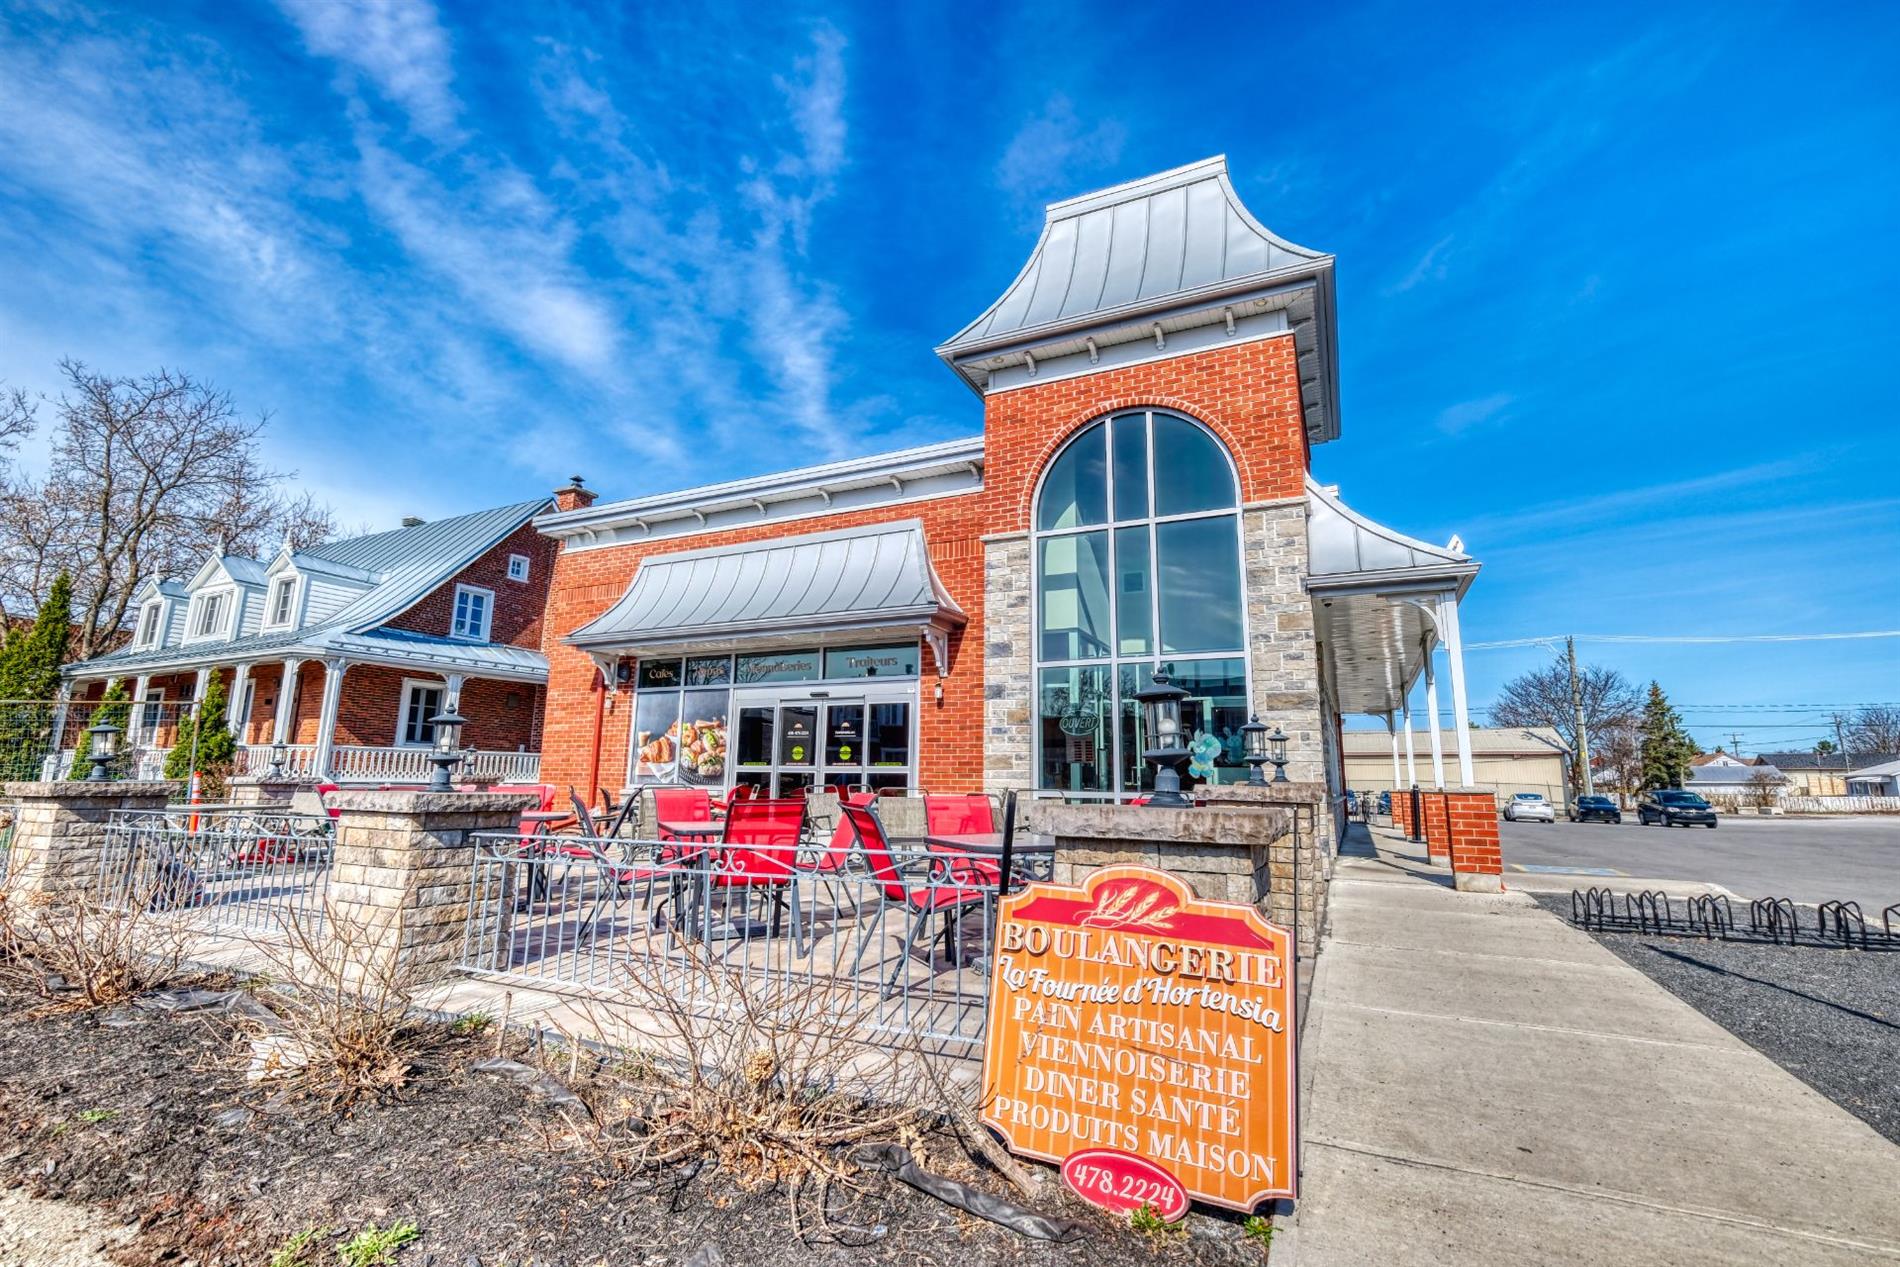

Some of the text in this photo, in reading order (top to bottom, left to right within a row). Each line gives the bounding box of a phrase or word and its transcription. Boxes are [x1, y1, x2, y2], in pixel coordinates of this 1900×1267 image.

[1062, 717, 1096, 729] OUVERT
[1001, 922, 1283, 989] BOULANGERIE
[1000, 955, 1284, 1033] La Fournée d'Hortensia
[1014, 996, 1263, 1064] PAIN ARTISANAL
[1021, 1031, 1251, 1100] VIENNOISERIE
[1024, 1065, 1241, 1137] DINER SANTÉ
[994, 1095, 1278, 1185] PRODUITS MAISON
[1074, 1163, 1175, 1210] 478.2224
